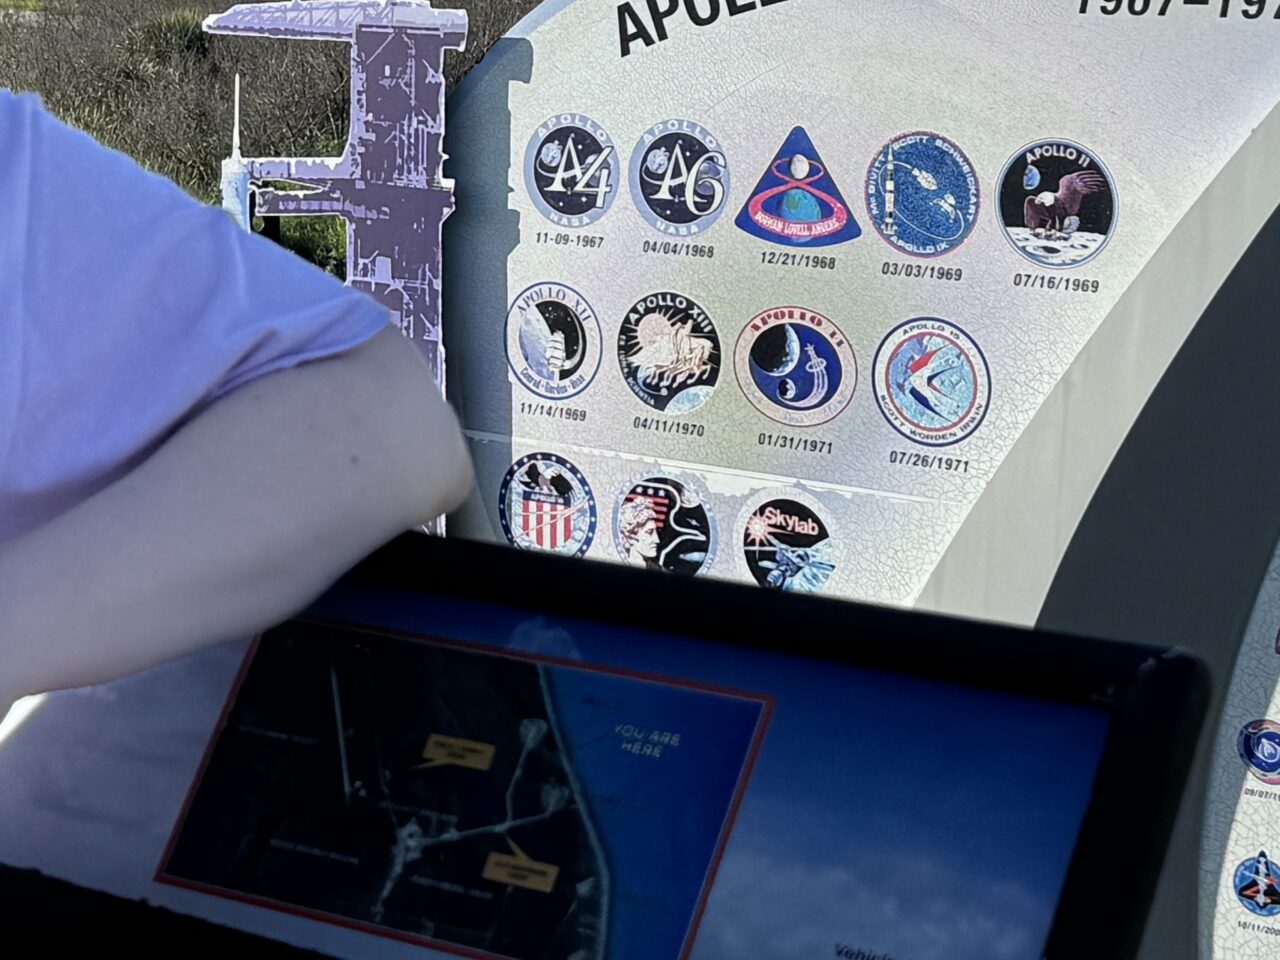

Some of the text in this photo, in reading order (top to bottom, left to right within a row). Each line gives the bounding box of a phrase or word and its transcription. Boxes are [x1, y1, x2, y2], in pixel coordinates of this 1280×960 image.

[536, 114, 608, 141] APOLLO
[642, 120, 717, 148] APOLLO
[893, 136, 928, 150] SCOTT
[1026, 145, 1091, 168] APOLLO 11
[549, 211, 590, 227] NASA
[656, 221, 699, 236] NASA
[536, 232, 604, 249] 11-09-1967
[642, 240, 715, 259] 04/04/1968
[890, 236, 949, 253] APOLLO IX
[761, 252, 836, 270] 12/21/1968
[882, 262, 963, 281] 03/03/1969
[1013, 273, 1100, 293] 07/16/1969
[517, 287, 592, 323] APOLLO XII
[628, 294, 714, 333] APOLLO XIII
[750, 309, 823, 333] APOLLO
[902, 323, 945, 336] APOLLO
[520, 402, 586, 422] 11/14/1969
[633, 416, 705, 437] 04/11/1970
[909, 428, 958, 441] WORDEN
[758, 433, 833, 454] 01/31/1971
[889, 450, 970, 473] 07/26/1971
[764, 506, 820, 536] Skylab
[614, 722, 645, 741] YOU
